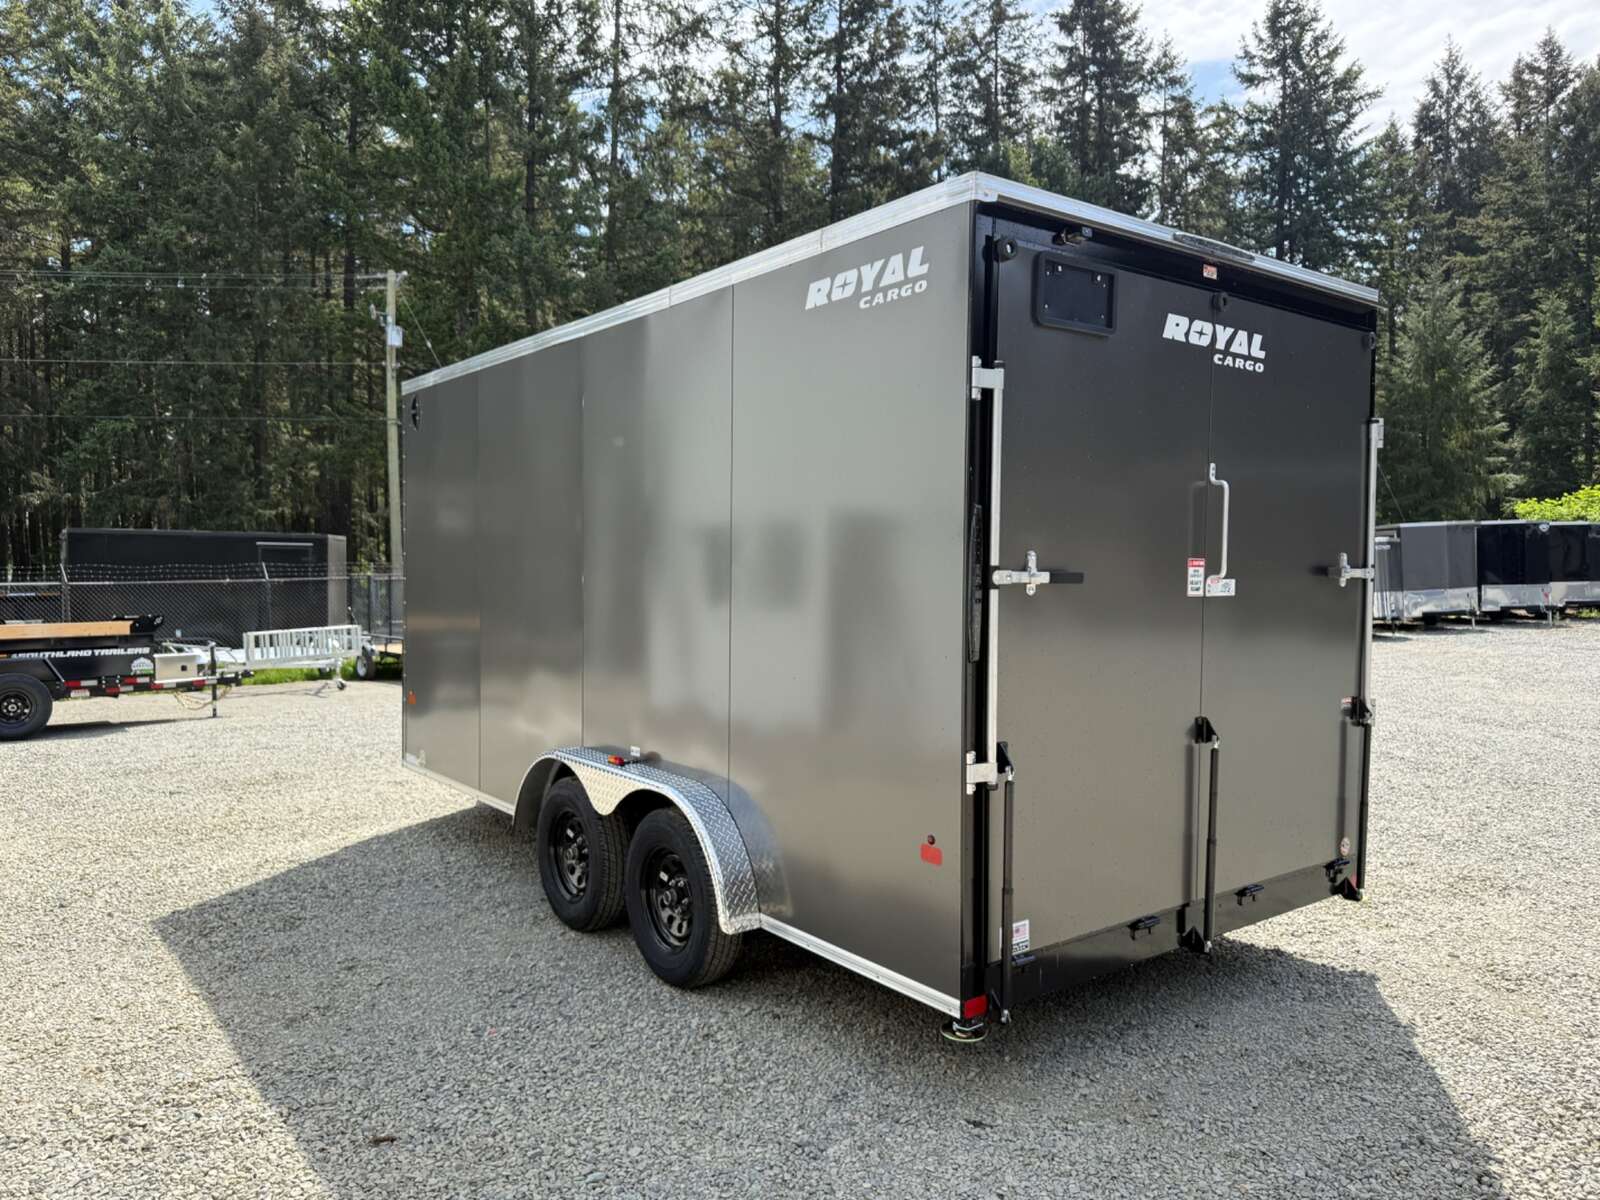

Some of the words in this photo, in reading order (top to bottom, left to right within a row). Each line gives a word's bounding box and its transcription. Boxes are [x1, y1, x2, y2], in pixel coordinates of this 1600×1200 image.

[805, 246, 929, 310] ROYAL
[859, 280, 928, 309] CARGO
[1162, 313, 1266, 359] ROYAL
[1213, 354, 1265, 373] CARGO
[93, 647, 150, 656] TRAILERS
